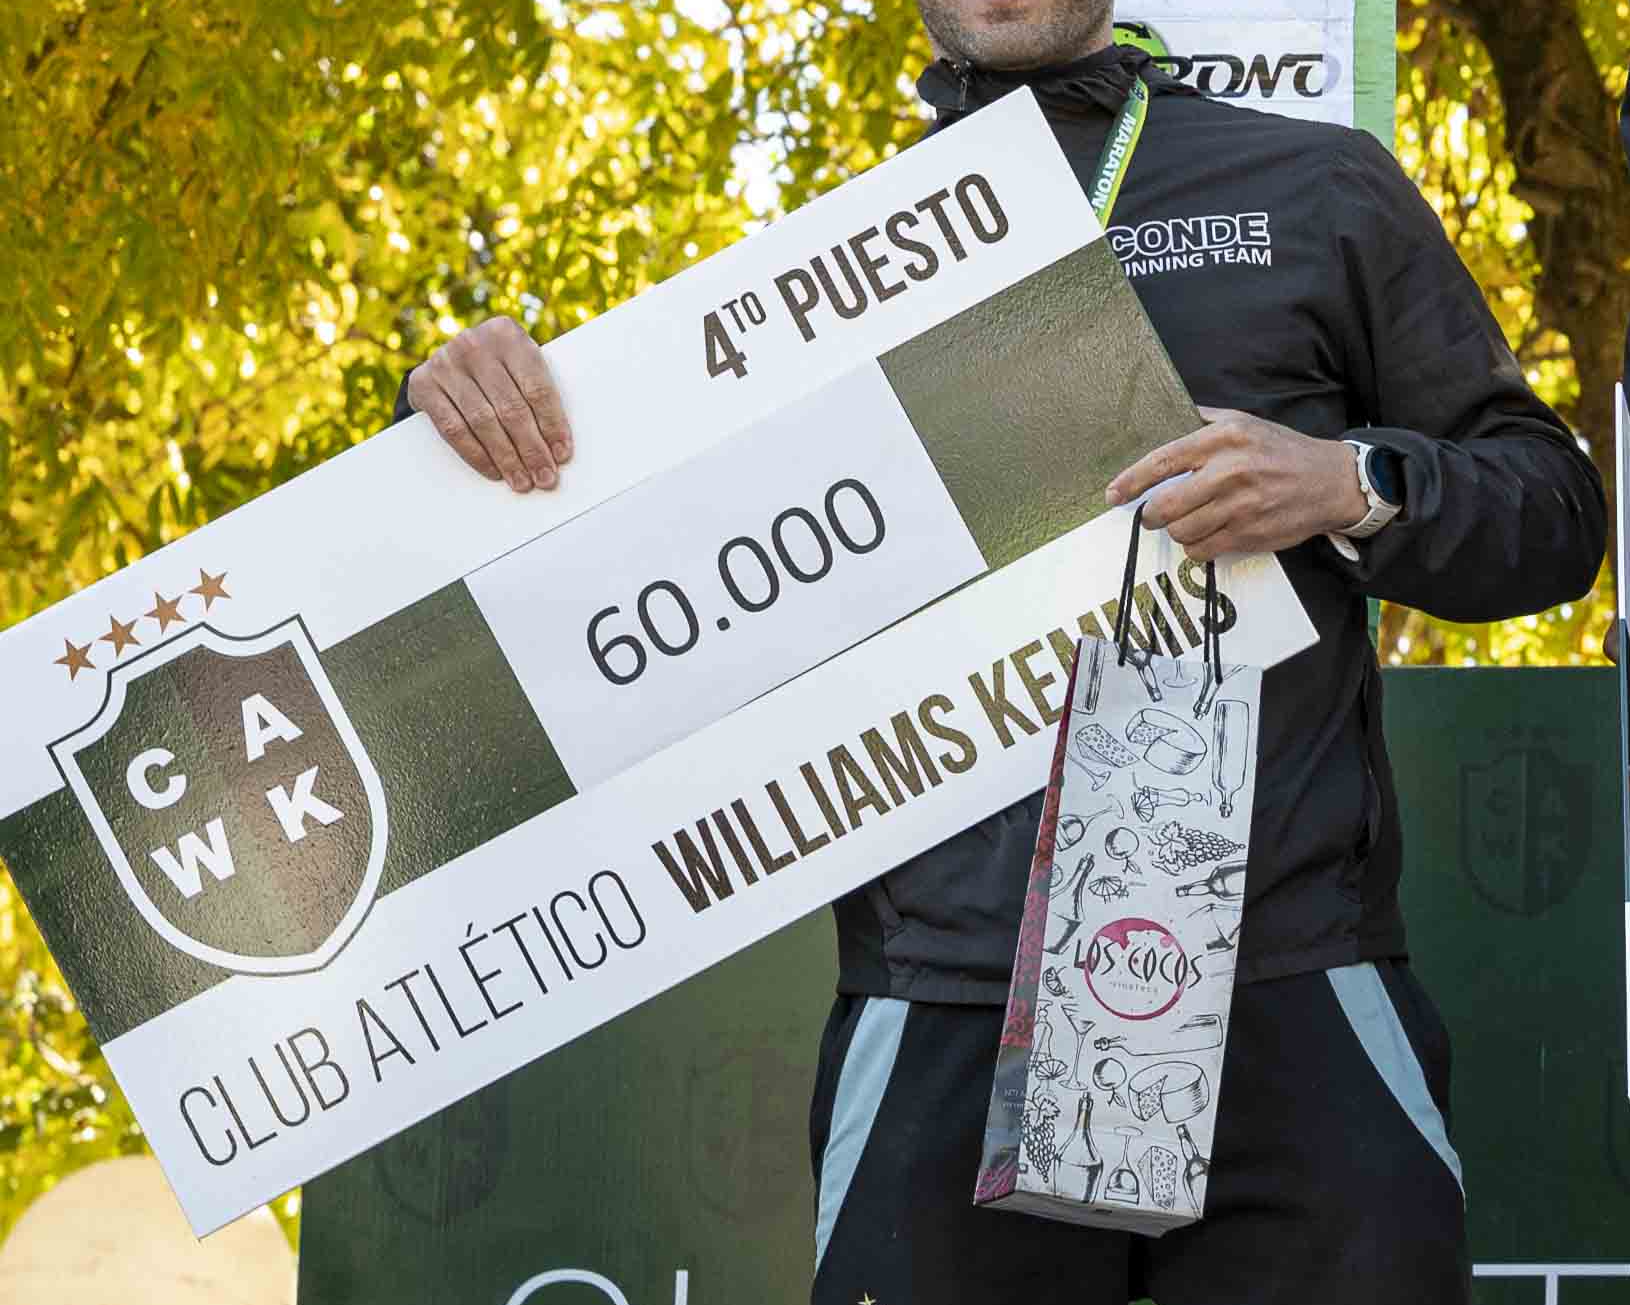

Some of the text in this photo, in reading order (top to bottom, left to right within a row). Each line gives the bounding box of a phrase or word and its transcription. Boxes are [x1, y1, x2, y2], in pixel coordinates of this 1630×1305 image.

[773, 172, 1010, 343] PUESTO
[1104, 212, 1271, 261] CONDE
[1124, 248, 1272, 277] UNNING TEAM
[586, 477, 887, 686] 60.000
[126, 692, 304, 810] C A
[150, 765, 346, 900] W K
[179, 1026, 350, 1168] CLUB
[355, 869, 648, 1083] ATLÉTICO
[651, 693, 979, 915] WILLIAMS
[1074, 937, 1203, 990] LOS COCOS
